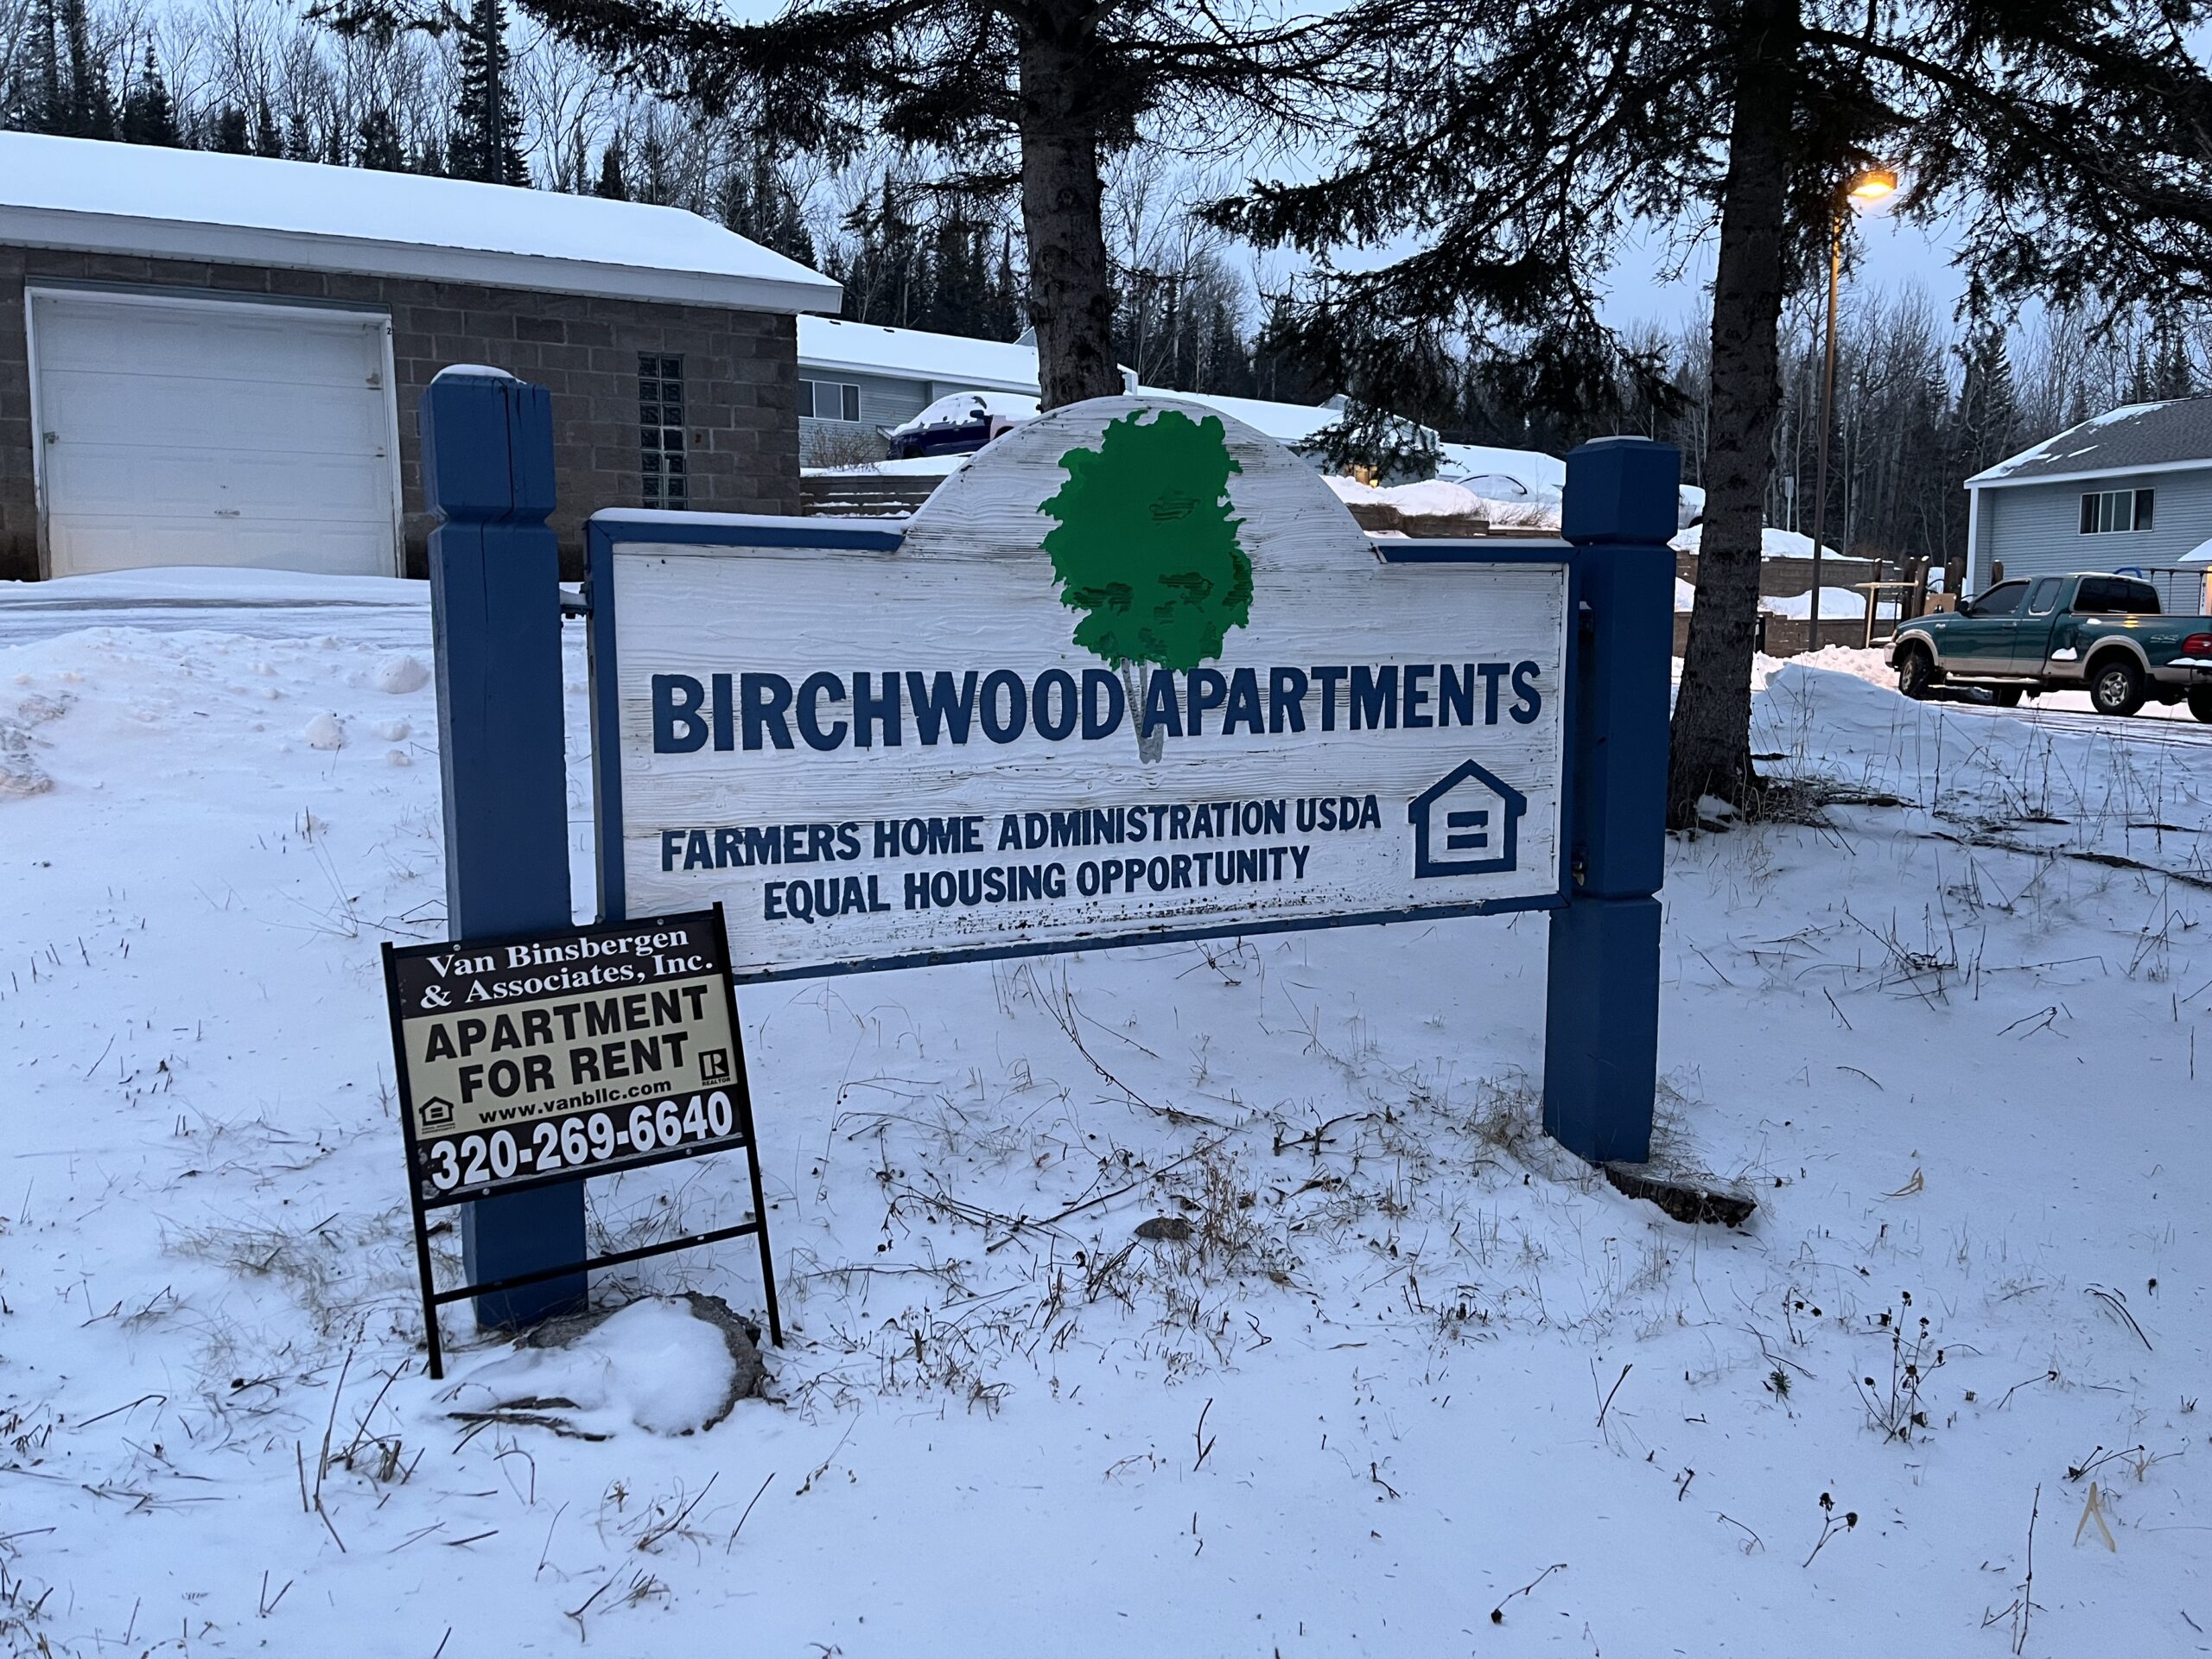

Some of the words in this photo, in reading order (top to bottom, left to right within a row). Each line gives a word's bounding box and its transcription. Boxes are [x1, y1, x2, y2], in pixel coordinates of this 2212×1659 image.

[652, 668, 1124, 753] BIRCHWOOD
[1141, 660, 1541, 738] APARTMENTS
[661, 821, 861, 871] FARMERS
[874, 816, 983, 858] HOME
[997, 798, 1287, 851] ADMINISTRATION
[1296, 794, 1382, 832] USDA
[764, 875, 891, 924] EQUAL
[904, 864, 1066, 910] HOUSING
[1076, 845, 1311, 896] OPPORTUNITY
[420, 984, 452, 1009] &
[464, 963, 645, 1002] Associates,
[652, 954, 714, 976] Inc.
[426, 954, 497, 978] Van
[505, 930, 689, 969] Binsbergen
[424, 984, 708, 1063] APARTMENT
[458, 1053, 556, 1104] FOR
[569, 1031, 689, 1085] RENT
[479, 1078, 671, 1123] www.vanbllc.com
[702, 1077, 731, 1086] REALTOR
[431, 1090, 733, 1190] 320-269-6640
